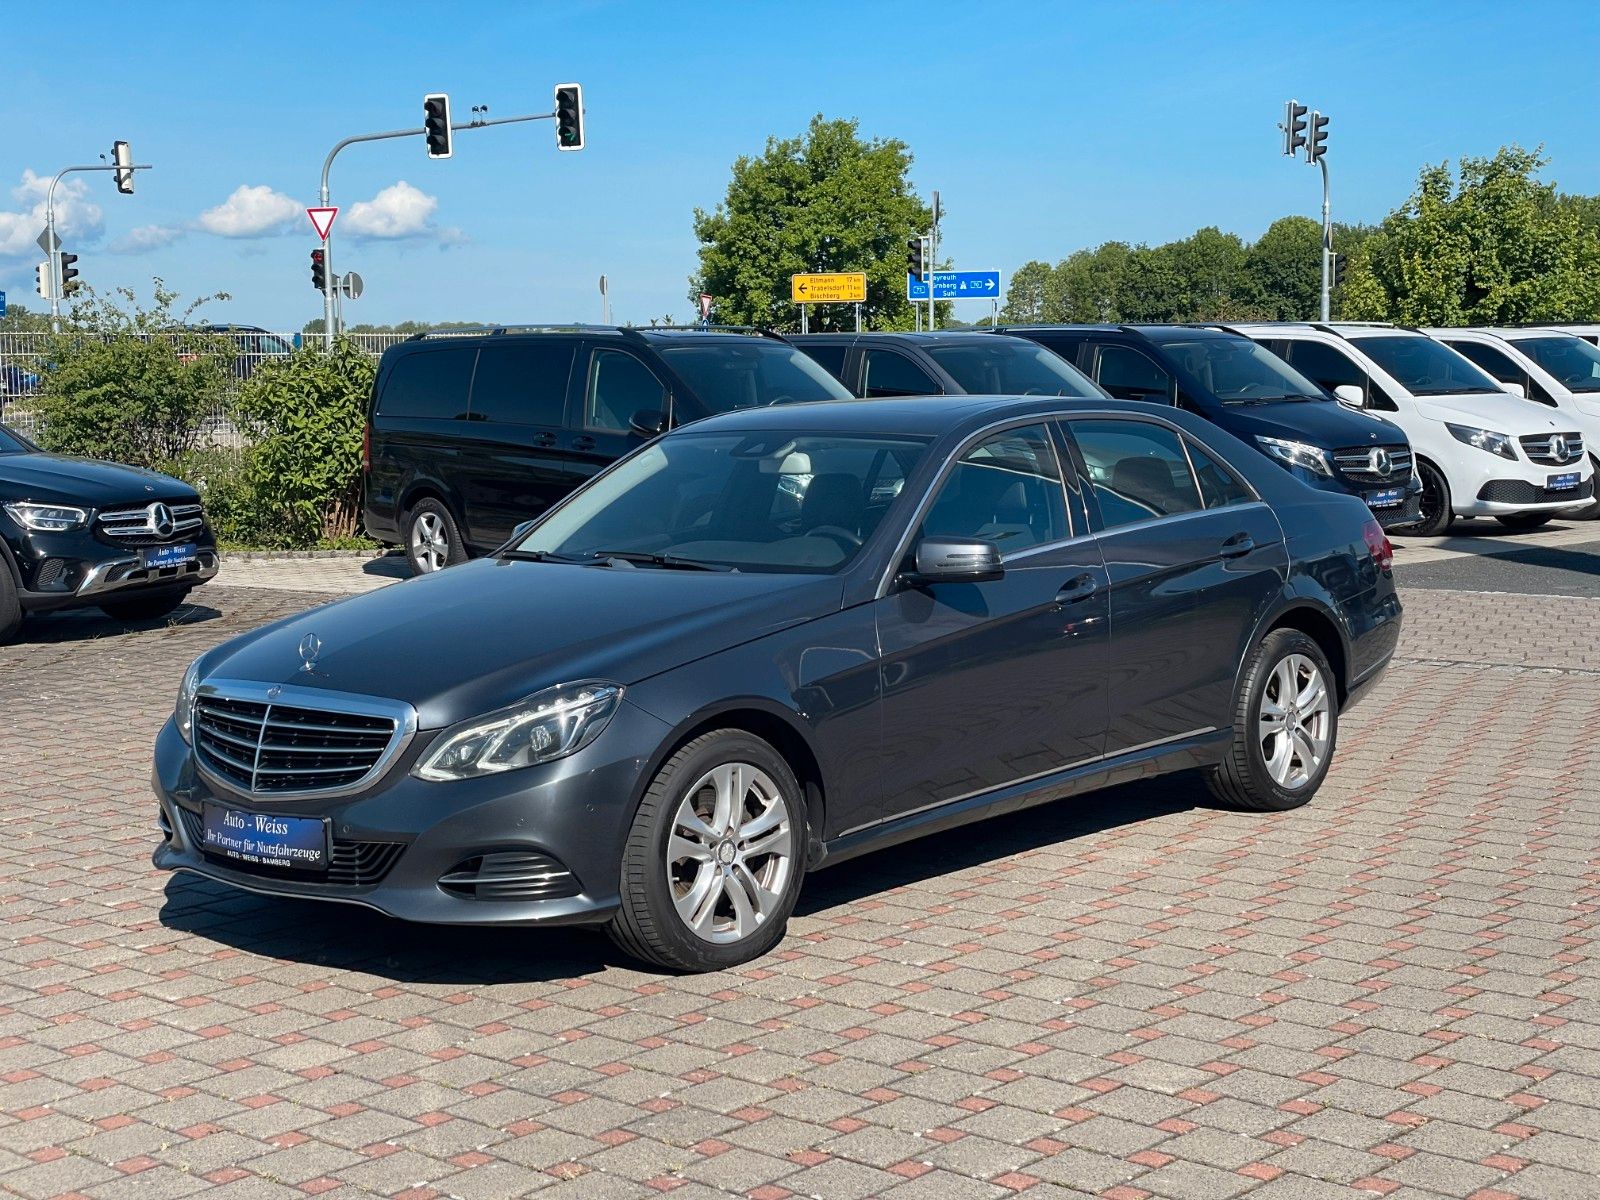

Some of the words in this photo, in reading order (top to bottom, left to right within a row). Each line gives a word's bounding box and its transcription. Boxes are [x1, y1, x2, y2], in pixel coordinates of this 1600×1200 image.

[224, 810, 244, 829] Auto
[256, 816, 288, 835] Weiss
[207, 829, 216, 840] Ihr
[217, 832, 241, 848] Partner
[243, 839, 255, 852] für
[257, 841, 320, 861] Nutzfahrzeuge
[263, 857, 291, 866] BAMBERG
